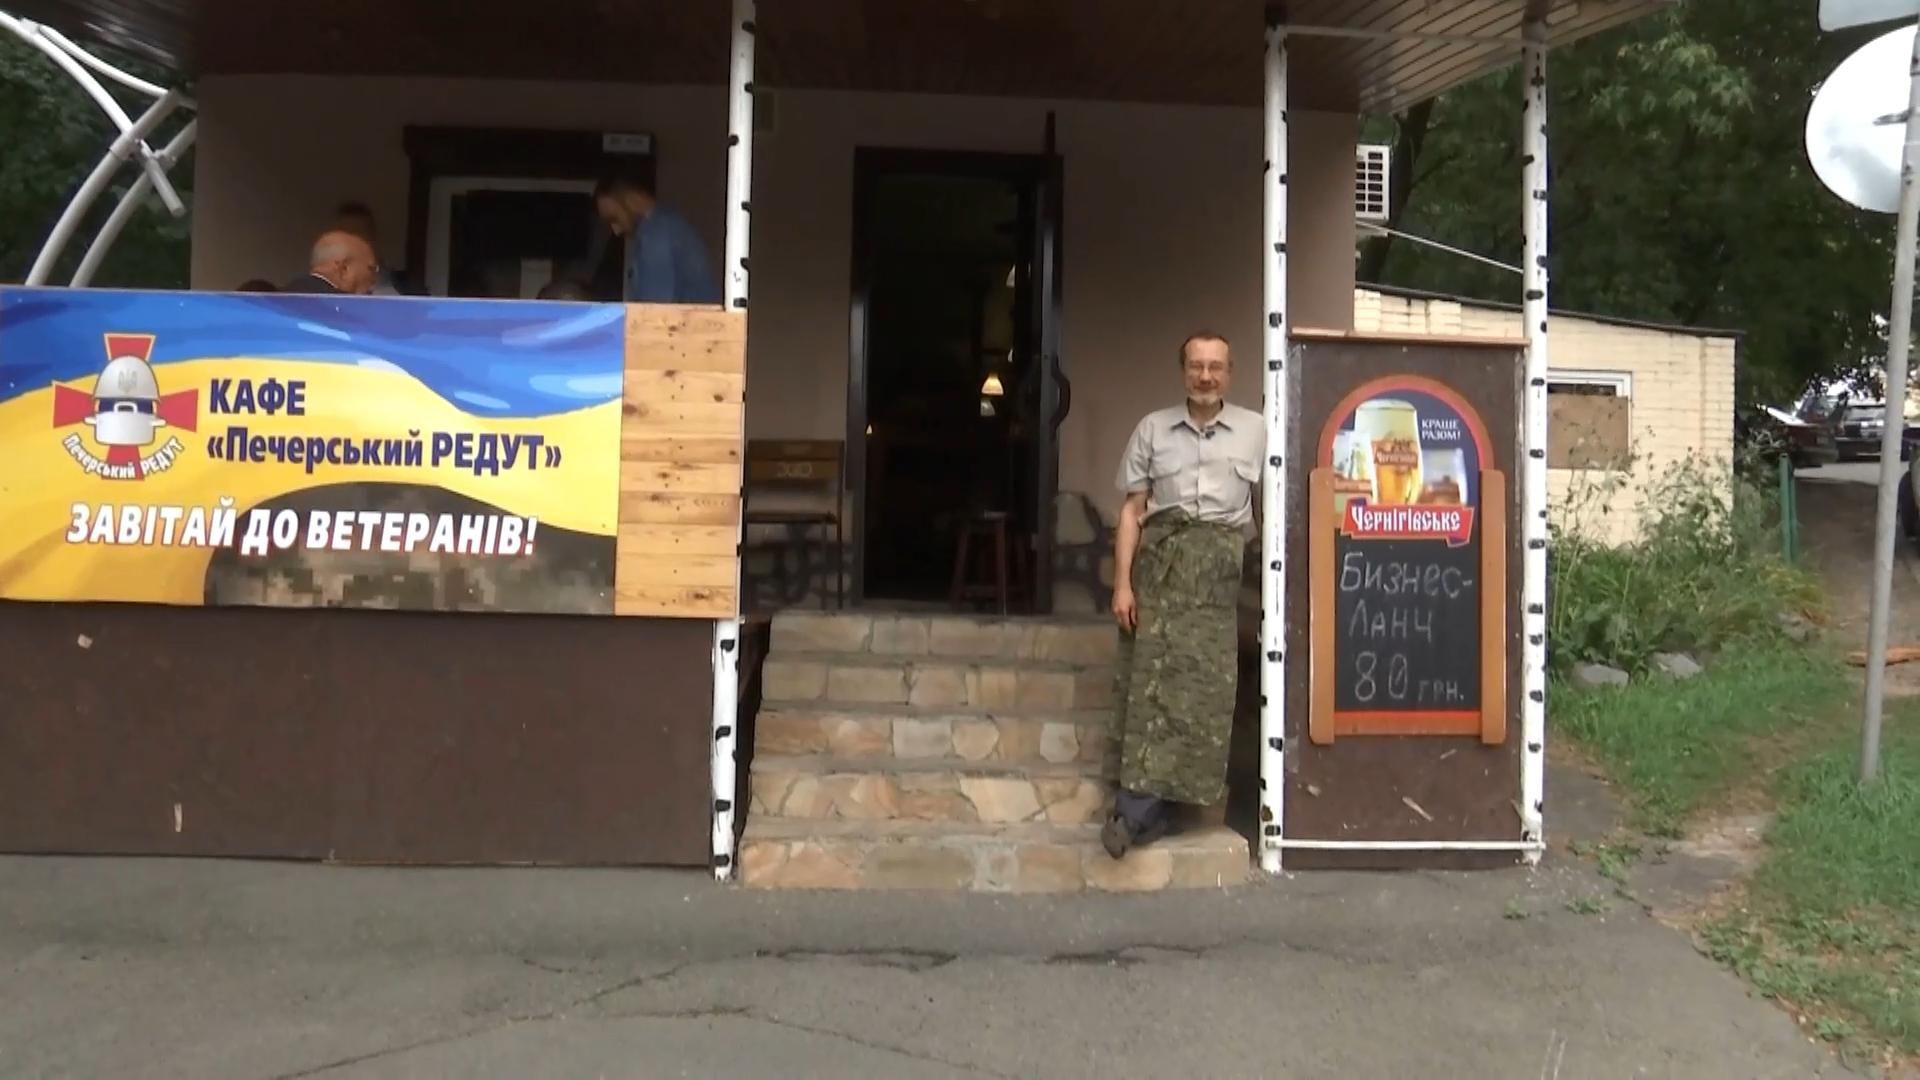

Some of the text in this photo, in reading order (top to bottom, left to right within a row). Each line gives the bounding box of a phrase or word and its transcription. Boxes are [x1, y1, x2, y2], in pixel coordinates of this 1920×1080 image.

[209, 378, 306, 416] КАФЕ
[1421, 419, 1459, 430] КРАШЕ
[1421, 430, 1461, 440] РАЗОМ!
[63, 432, 184, 479] Печерський РЕДУТ
[207, 427, 562, 476] «Печерський РЕДУТ»
[66, 496, 538, 556] ЗАВІТАЙ ДО ВЕТЕРАНІВ!
[1351, 505, 1461, 532] Чернігівське
[1340, 552, 1473, 599] Бизнес-
[1355, 652, 1408, 701] 80
